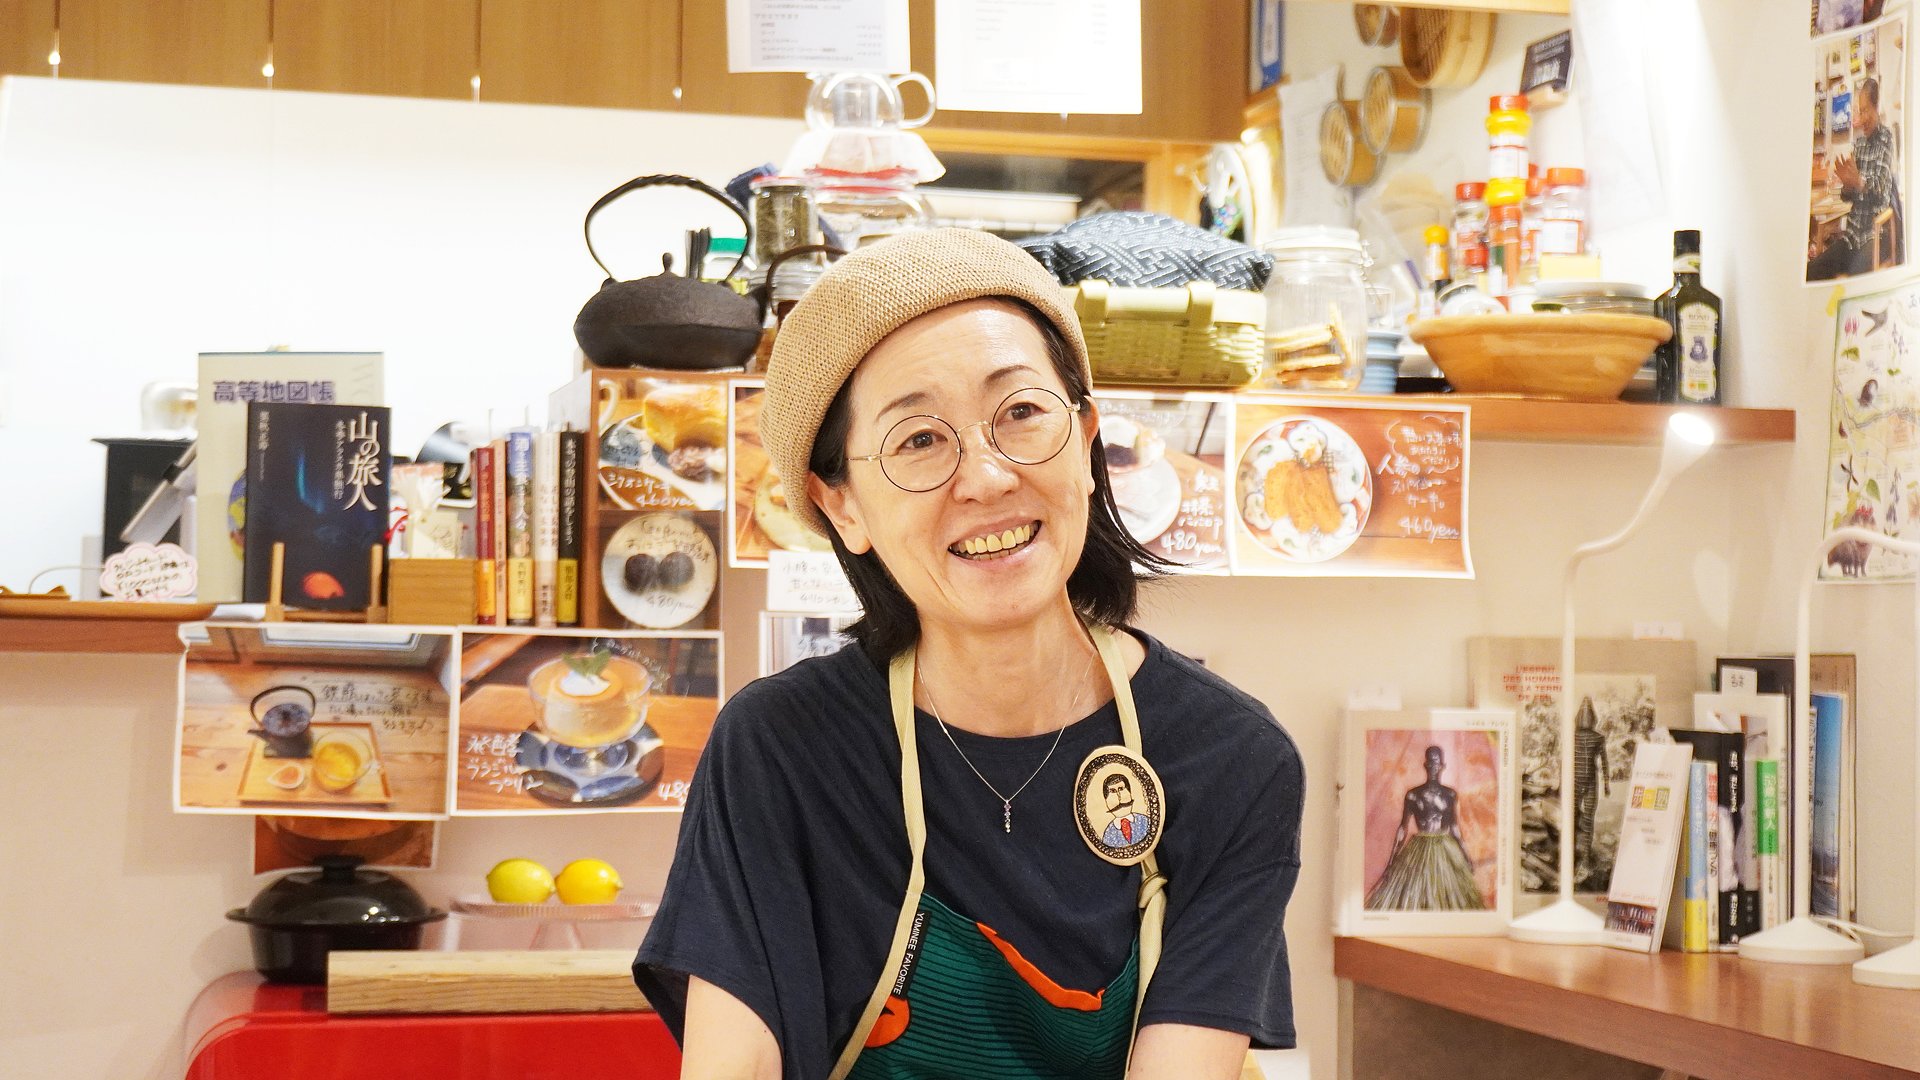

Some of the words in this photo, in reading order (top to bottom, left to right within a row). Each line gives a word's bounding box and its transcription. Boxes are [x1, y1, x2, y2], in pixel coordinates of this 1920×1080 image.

[213, 381, 335, 403] 高等地図帳
[343, 411, 383, 511] 山の旅人
[1400, 515, 1459, 544] 460yen
[1524, 675, 1561, 683] HOMME
[488, 774, 545, 795] プリン
[907, 912, 925, 951] YUMINEE
[893, 953, 914, 995] FAVORITE
